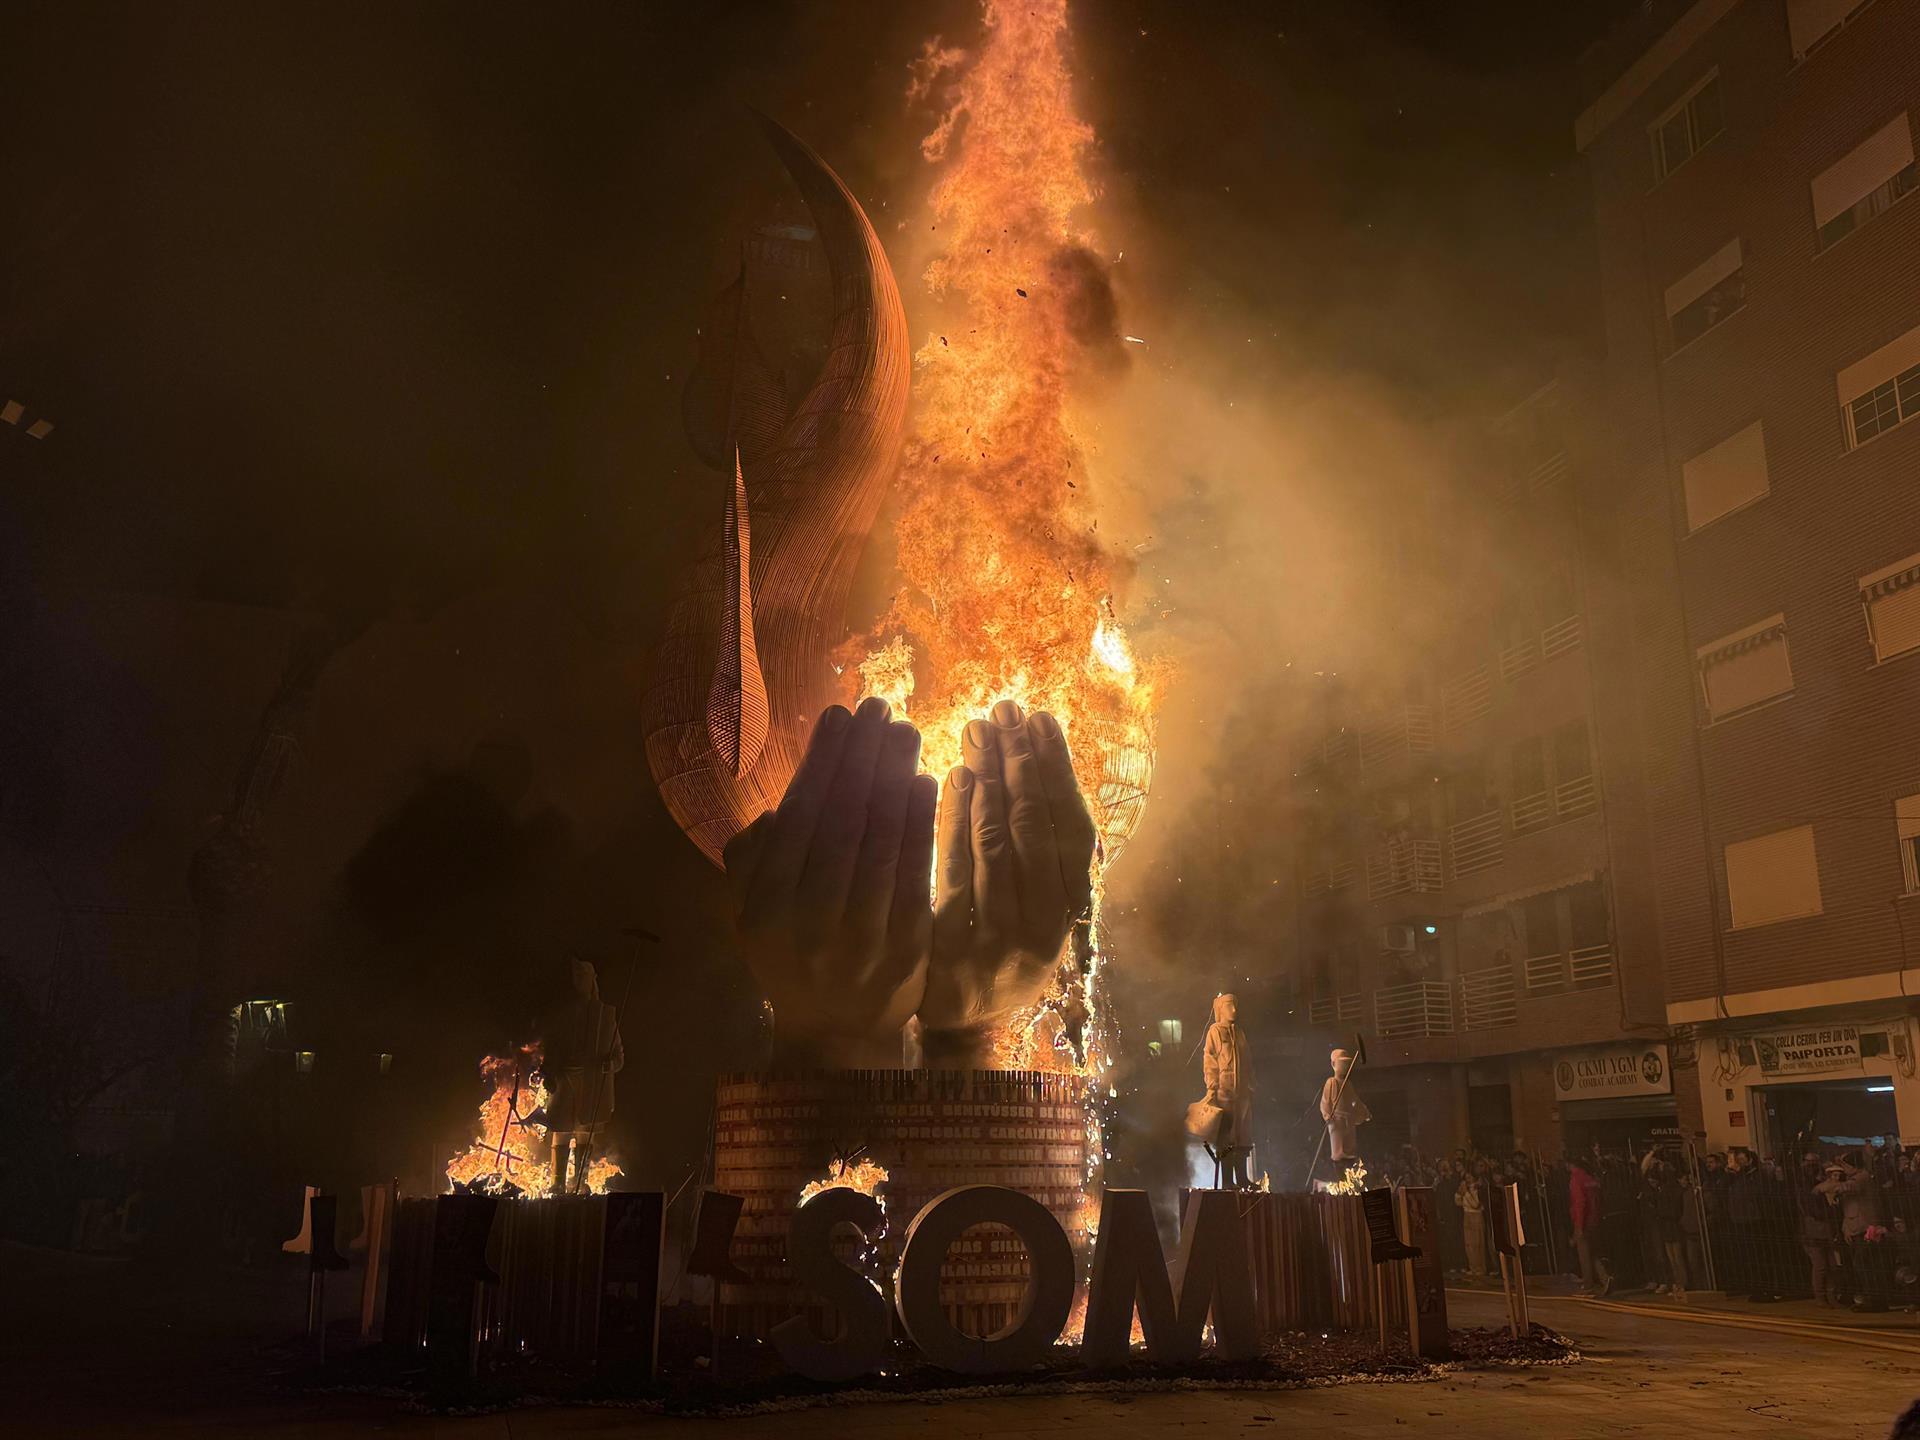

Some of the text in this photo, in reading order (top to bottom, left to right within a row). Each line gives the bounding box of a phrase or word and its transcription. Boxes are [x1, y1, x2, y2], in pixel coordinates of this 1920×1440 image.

[1783, 1045, 1856, 1060] PAIPORTA
[1577, 1056, 1637, 1077] CKMI YGM
[1578, 1074, 1638, 1089] COMBAT ACADEMY
[943, 1102, 1034, 1119] BENETÚSSER
[770, 1184, 1258, 1381] SOM
